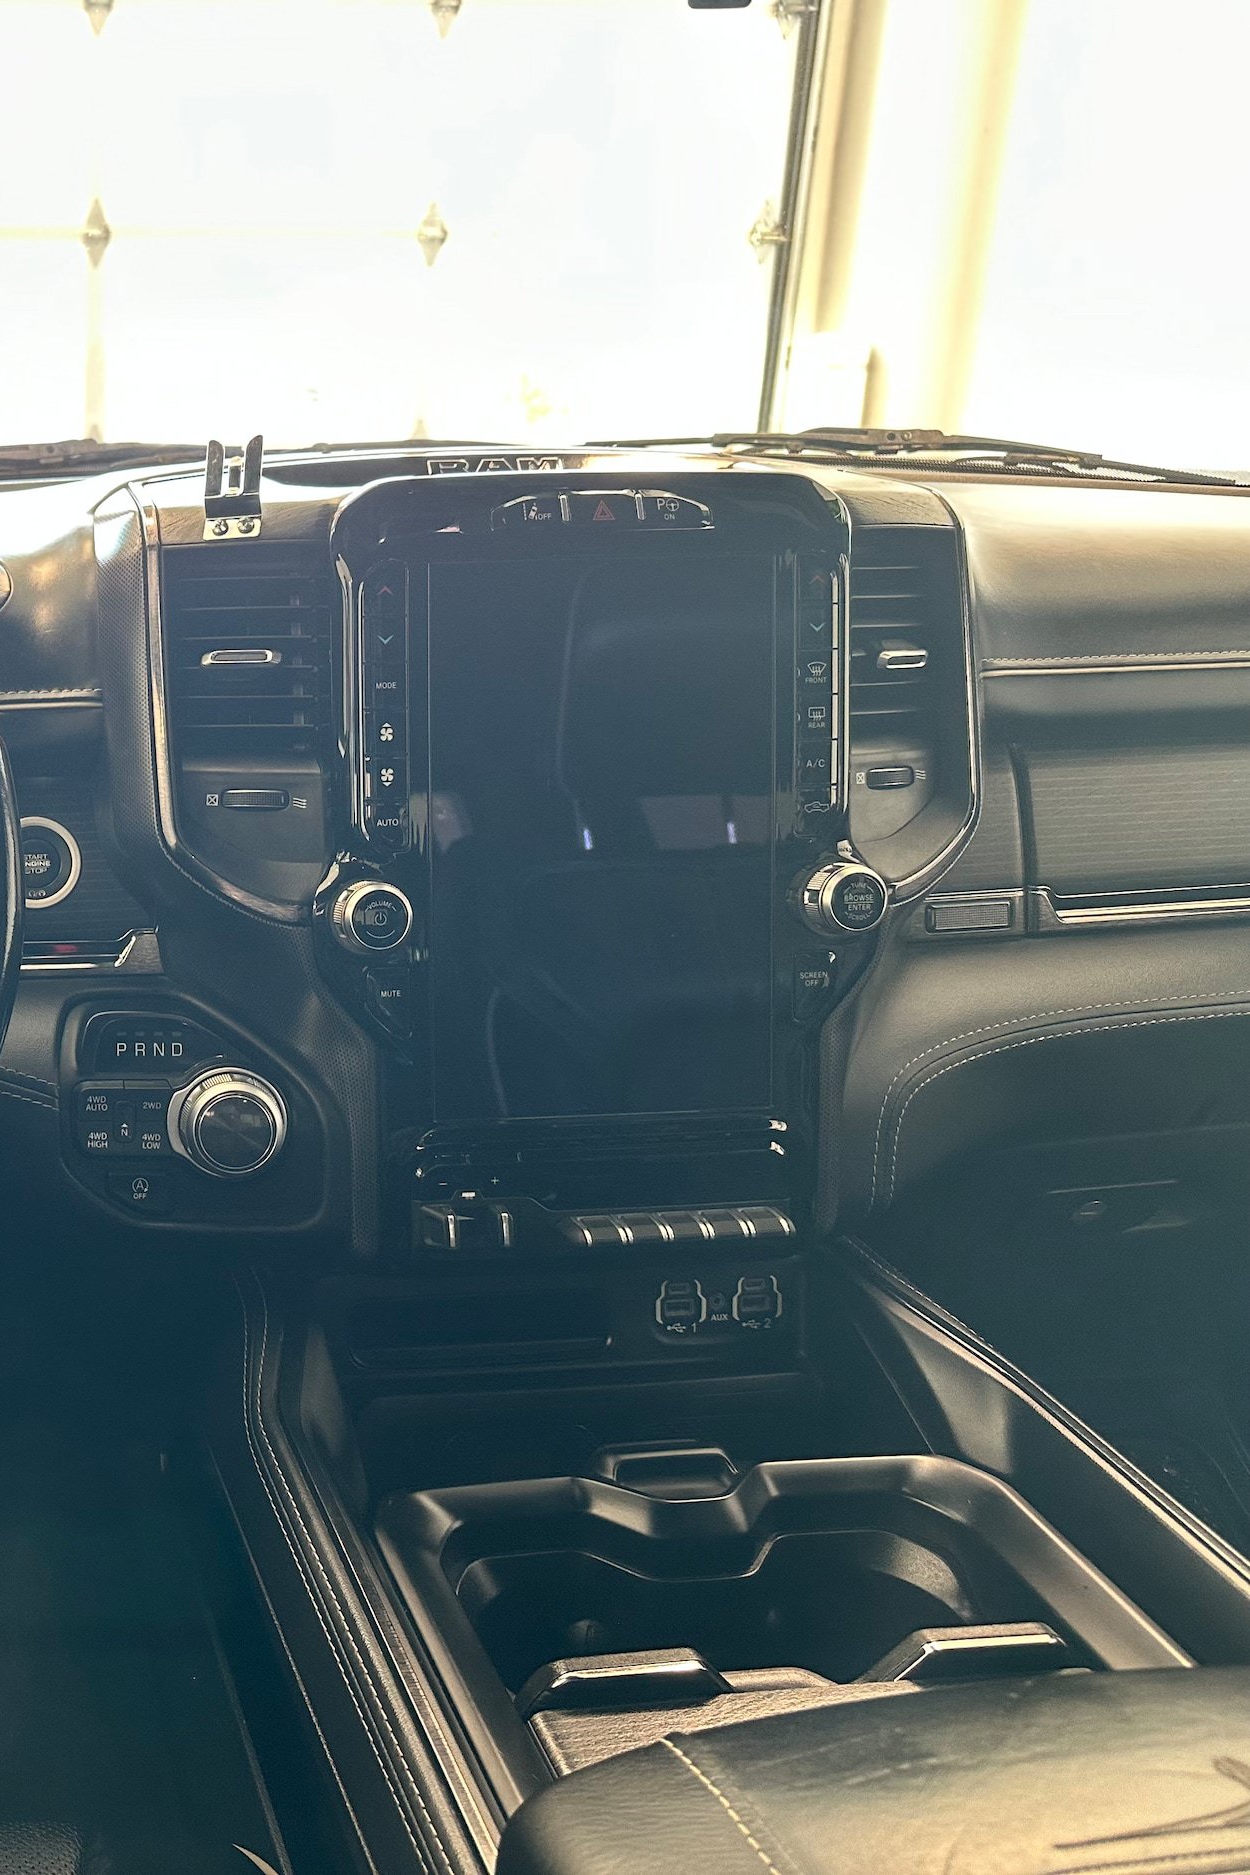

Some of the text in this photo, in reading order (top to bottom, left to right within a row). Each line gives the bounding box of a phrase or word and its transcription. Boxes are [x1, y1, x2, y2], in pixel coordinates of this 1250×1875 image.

[426, 456, 565, 475] RAM
[537, 512, 552, 521] OFF
[663, 513, 676, 521] ON
[805, 676, 827, 684] FRONT
[375, 681, 398, 690] MODE
[808, 721, 826, 729] REAR
[805, 758, 826, 769] A/C
[376, 818, 400, 827] AUTO
[843, 894, 875, 902] BROWSE
[367, 900, 393, 911] VOLUME
[847, 903, 872, 911] ENTER
[799, 971, 829, 980] SCREEN
[804, 979, 819, 987] OFF
[380, 989, 402, 998] MUTE
[116, 1042, 184, 1057] P R N D
[87, 1095, 107, 1104] 4WD
[85, 1102, 109, 1112] AUTO
[142, 1101, 162, 1110] 2WD
[88, 1132, 108, 1141] 4WD
[120, 1128, 129, 1137] N
[142, 1133, 161, 1142] 4WD
[87, 1140, 108, 1149] HIGH
[142, 1141, 161, 1150] LOW
[133, 1192, 147, 1200] OFF
[710, 1313, 729, 1322] AUX
[691, 1322, 697, 1333] 1
[764, 1318, 771, 1329] 2
